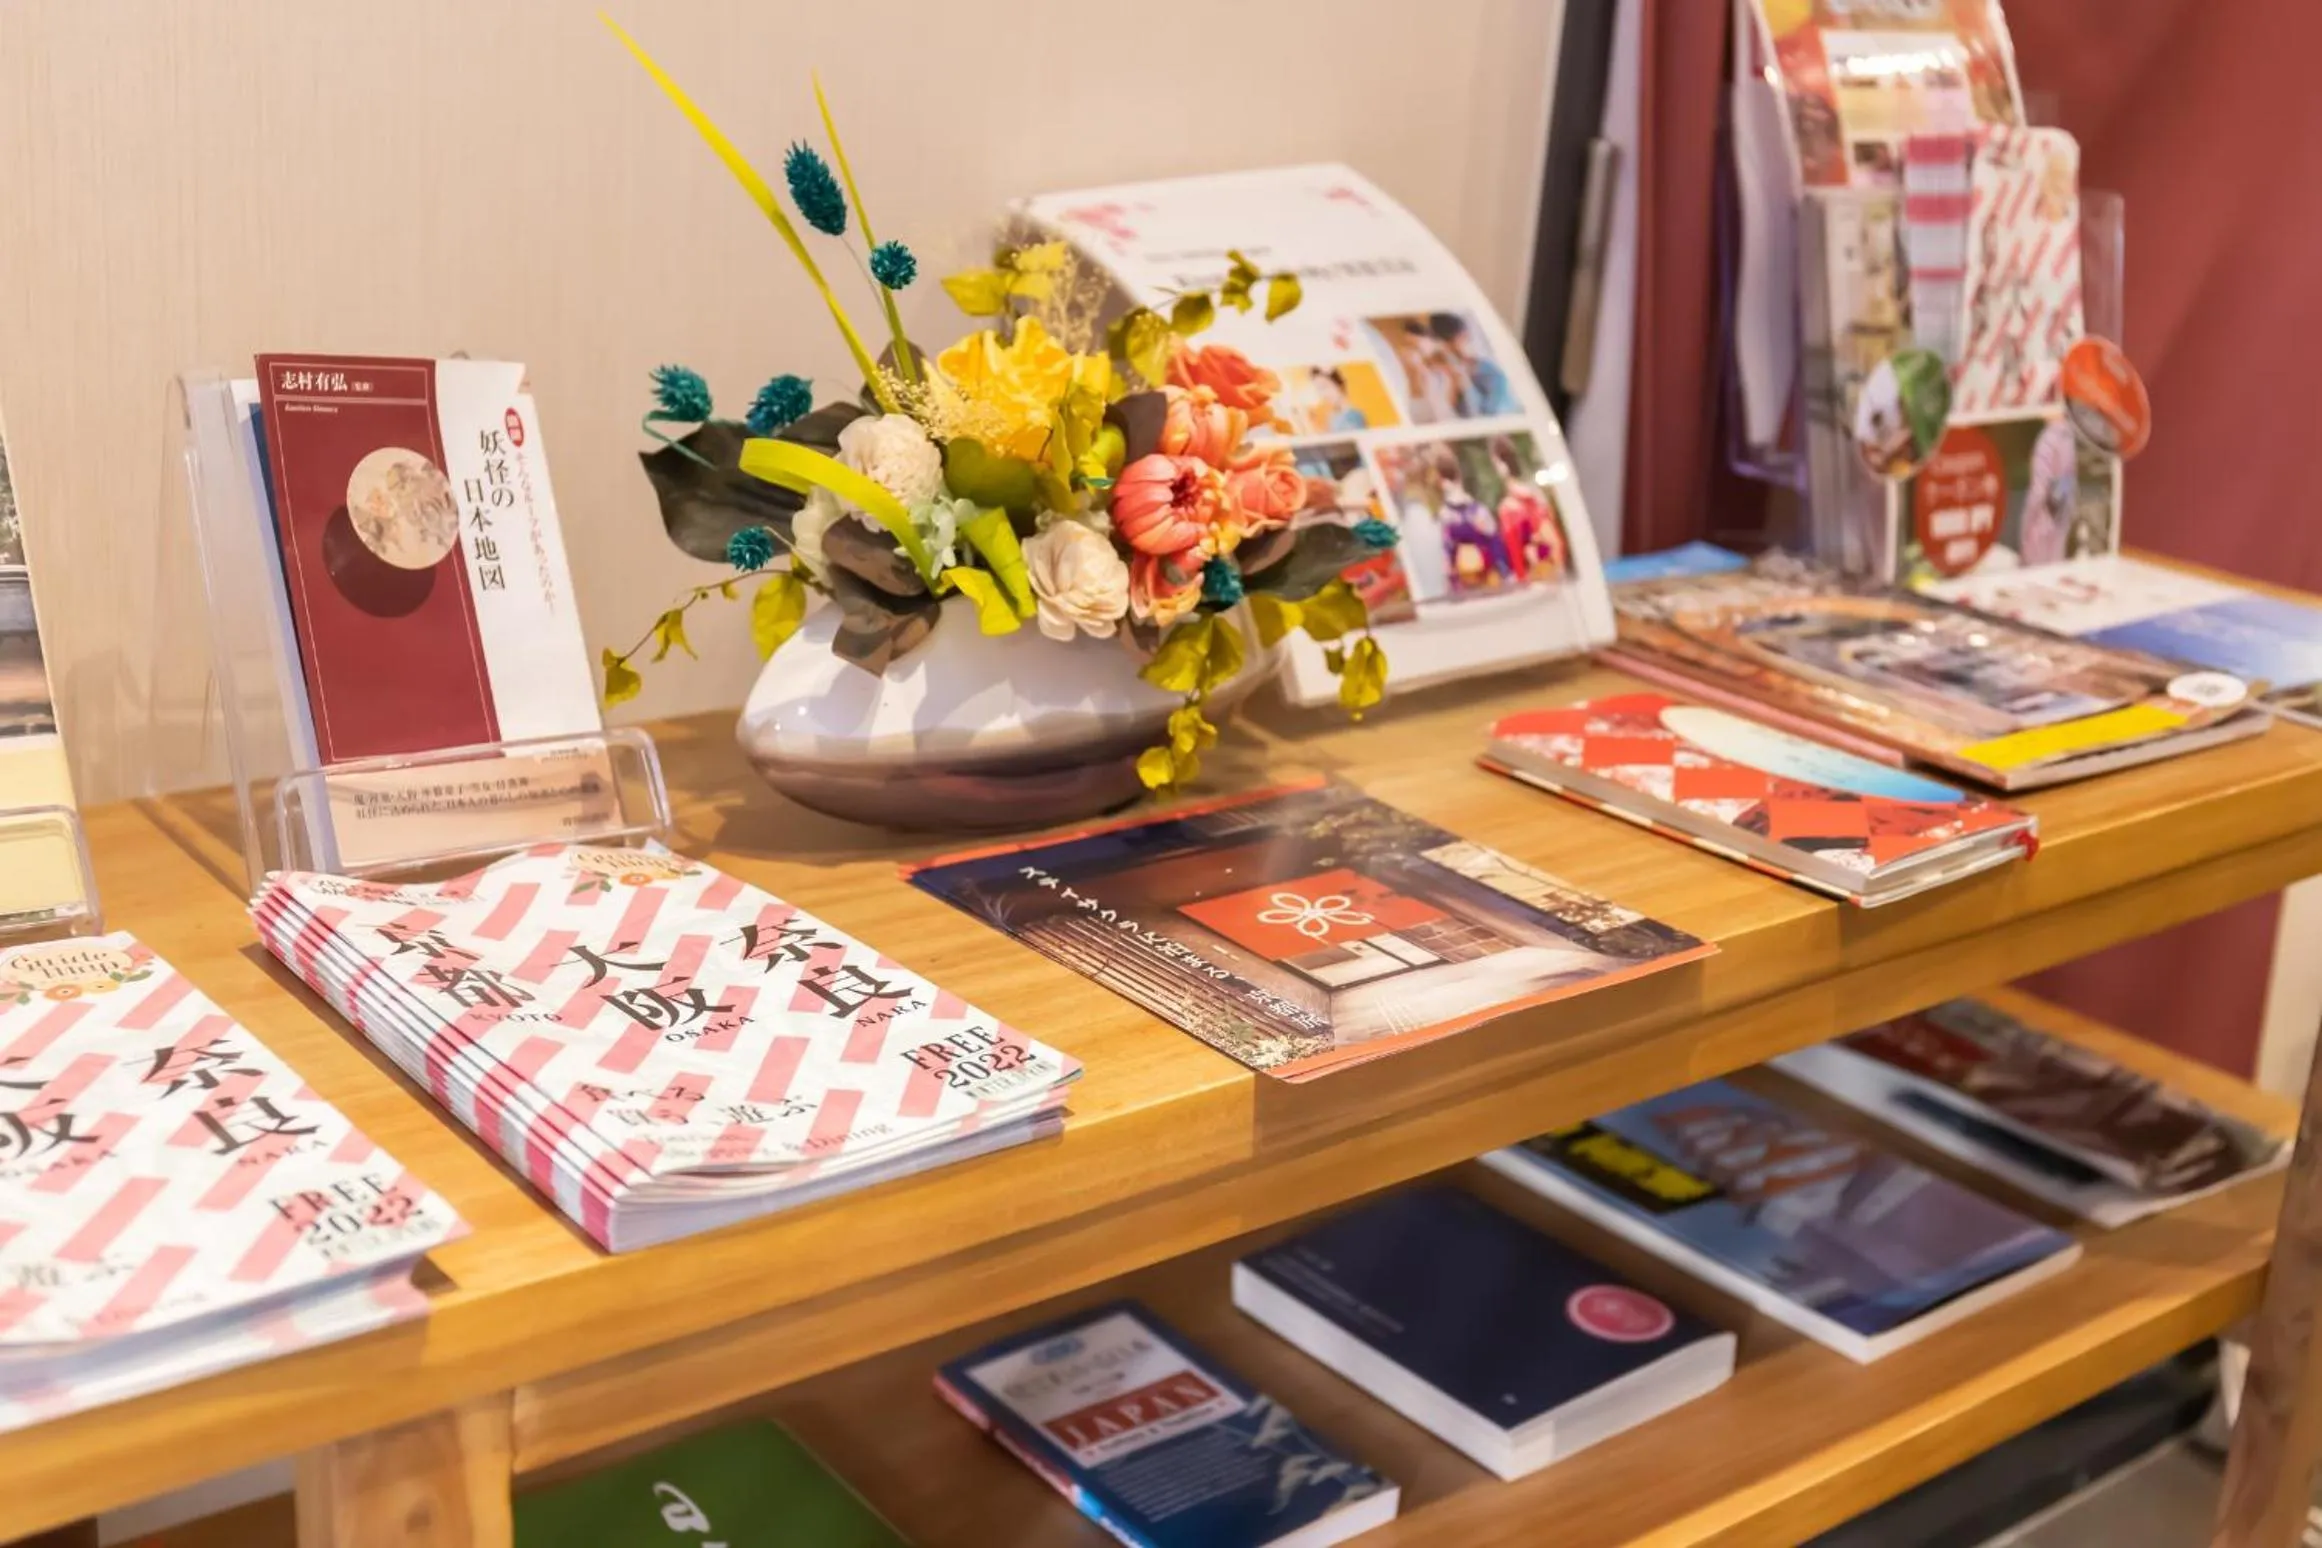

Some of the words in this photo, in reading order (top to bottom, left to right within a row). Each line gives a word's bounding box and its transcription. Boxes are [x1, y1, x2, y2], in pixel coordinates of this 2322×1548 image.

[281, 371, 348, 391] 志村有弘
[480, 429, 514, 508] 妖怪の
[464, 478, 505, 591] 日本地図
[357, 922, 537, 1009] 京都
[551, 941, 737, 1031] 大阪
[719, 918, 915, 1019] 奈良
[470, 1011, 564, 1025] KYOTO
[665, 1014, 755, 1043] OSAKA
[854, 998, 928, 1028] NARA
[900, 1025, 1005, 1071] FREE
[933, 1044, 1037, 1089] 2022
[122, 1039, 323, 1156] 奈良
[237, 1139, 329, 1167] NARA
[269, 1172, 398, 1221] FREE
[294, 1196, 424, 1246] 2022
[1066, 1383, 1207, 1450] JAPAN
